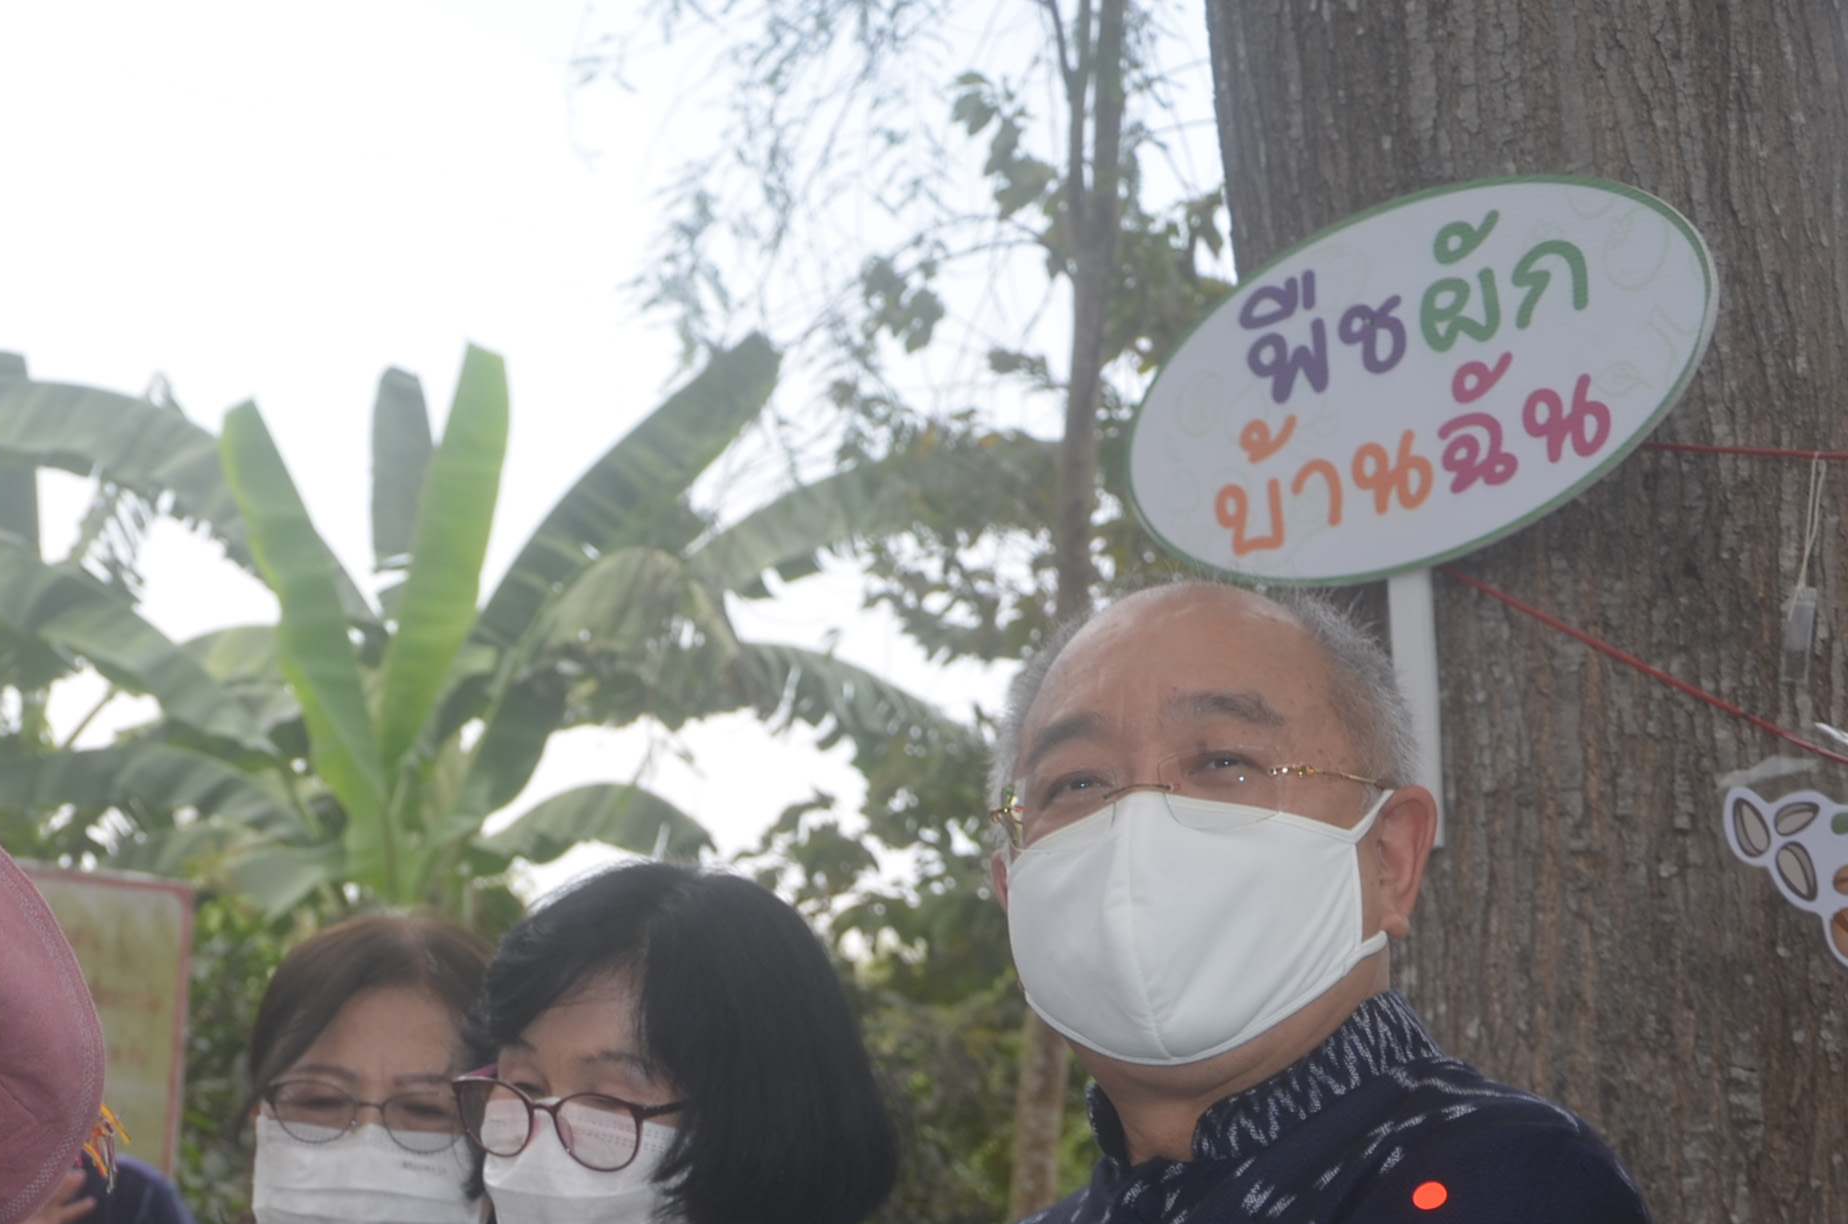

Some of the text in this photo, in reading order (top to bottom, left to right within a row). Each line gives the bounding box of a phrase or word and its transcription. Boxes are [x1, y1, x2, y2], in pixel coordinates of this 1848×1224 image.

[1239, 209, 1589, 404] พืชผัก
[1213, 351, 1612, 557] บ้านฉัน
